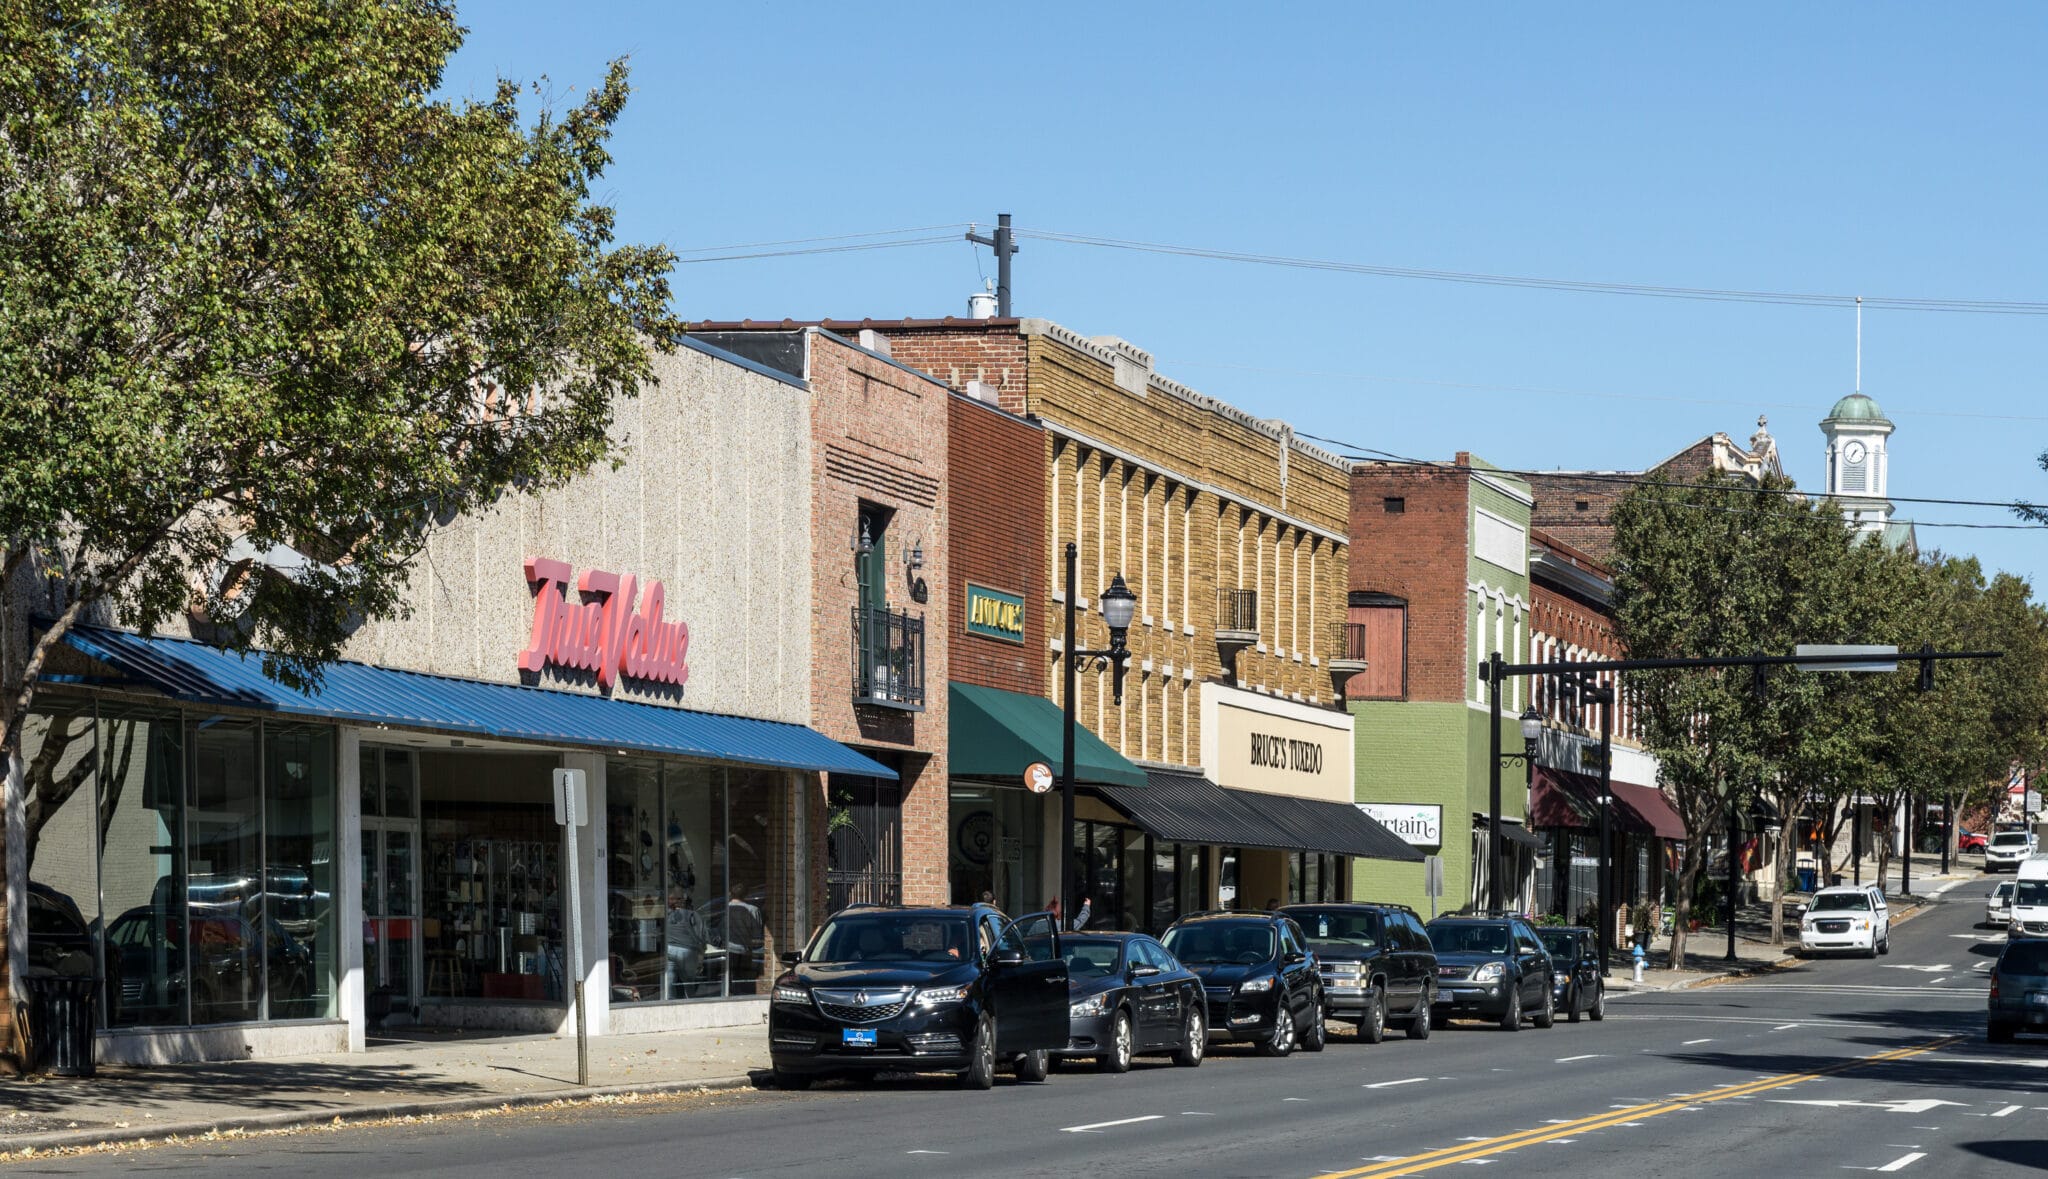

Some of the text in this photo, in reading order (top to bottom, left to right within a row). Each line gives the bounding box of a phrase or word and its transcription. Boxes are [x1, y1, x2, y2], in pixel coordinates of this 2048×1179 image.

[518, 556, 689, 688] True Value
[971, 594, 1023, 633] ANTIQUES
[1250, 732, 1323, 775] BRUCE'S TUXEDO
